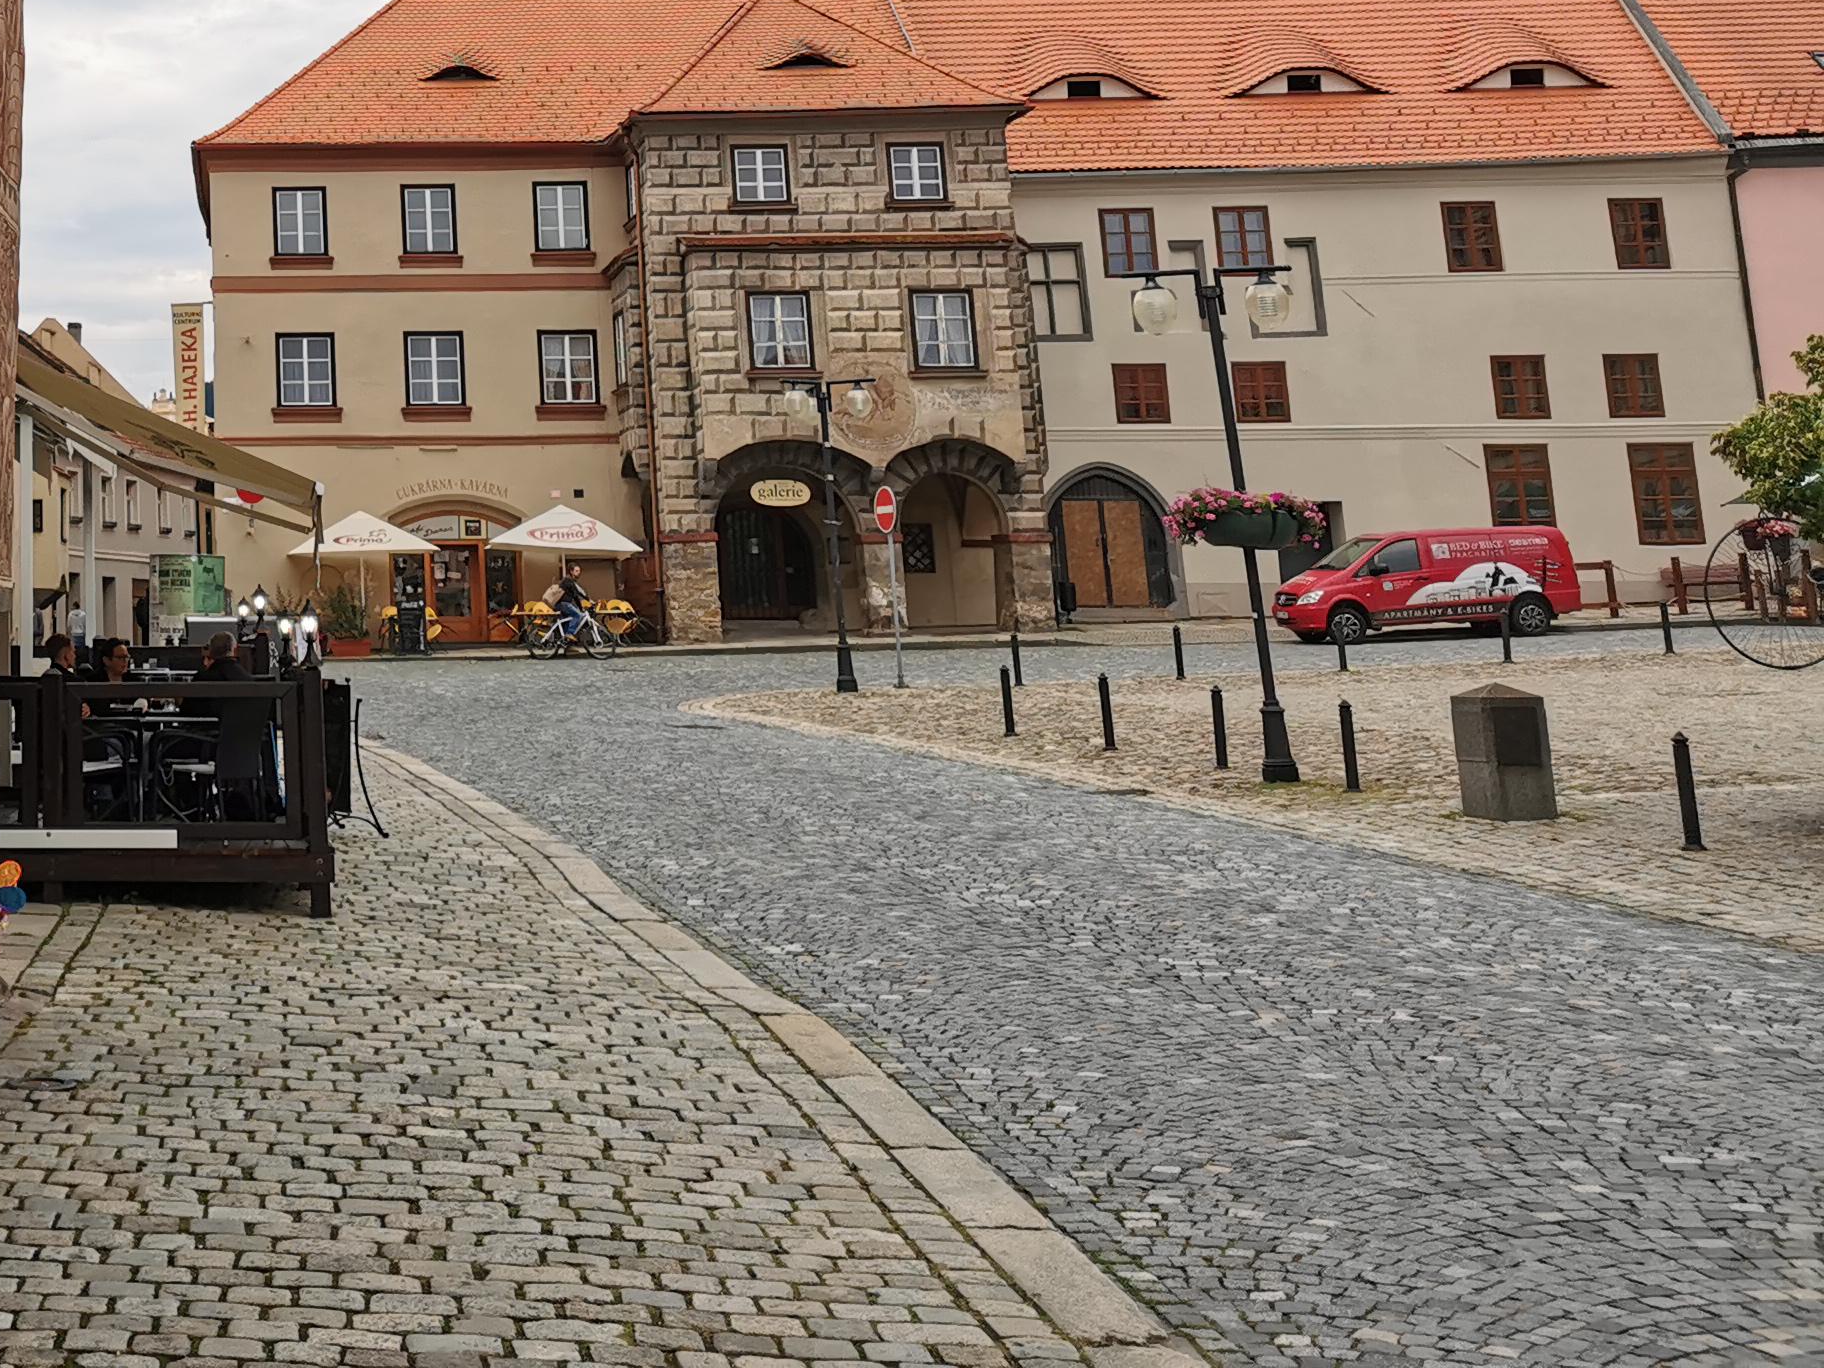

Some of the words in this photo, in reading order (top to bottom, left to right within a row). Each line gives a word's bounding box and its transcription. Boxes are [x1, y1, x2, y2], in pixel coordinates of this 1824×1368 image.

[181, 327, 197, 400] HAJEKA
[757, 483, 804, 501] galerie
[539, 530, 585, 542] Prima
[1448, 542, 1470, 551] BED
[1479, 540, 1505, 550] BIKE
[1457, 604, 1494, 615] E-BIKES
